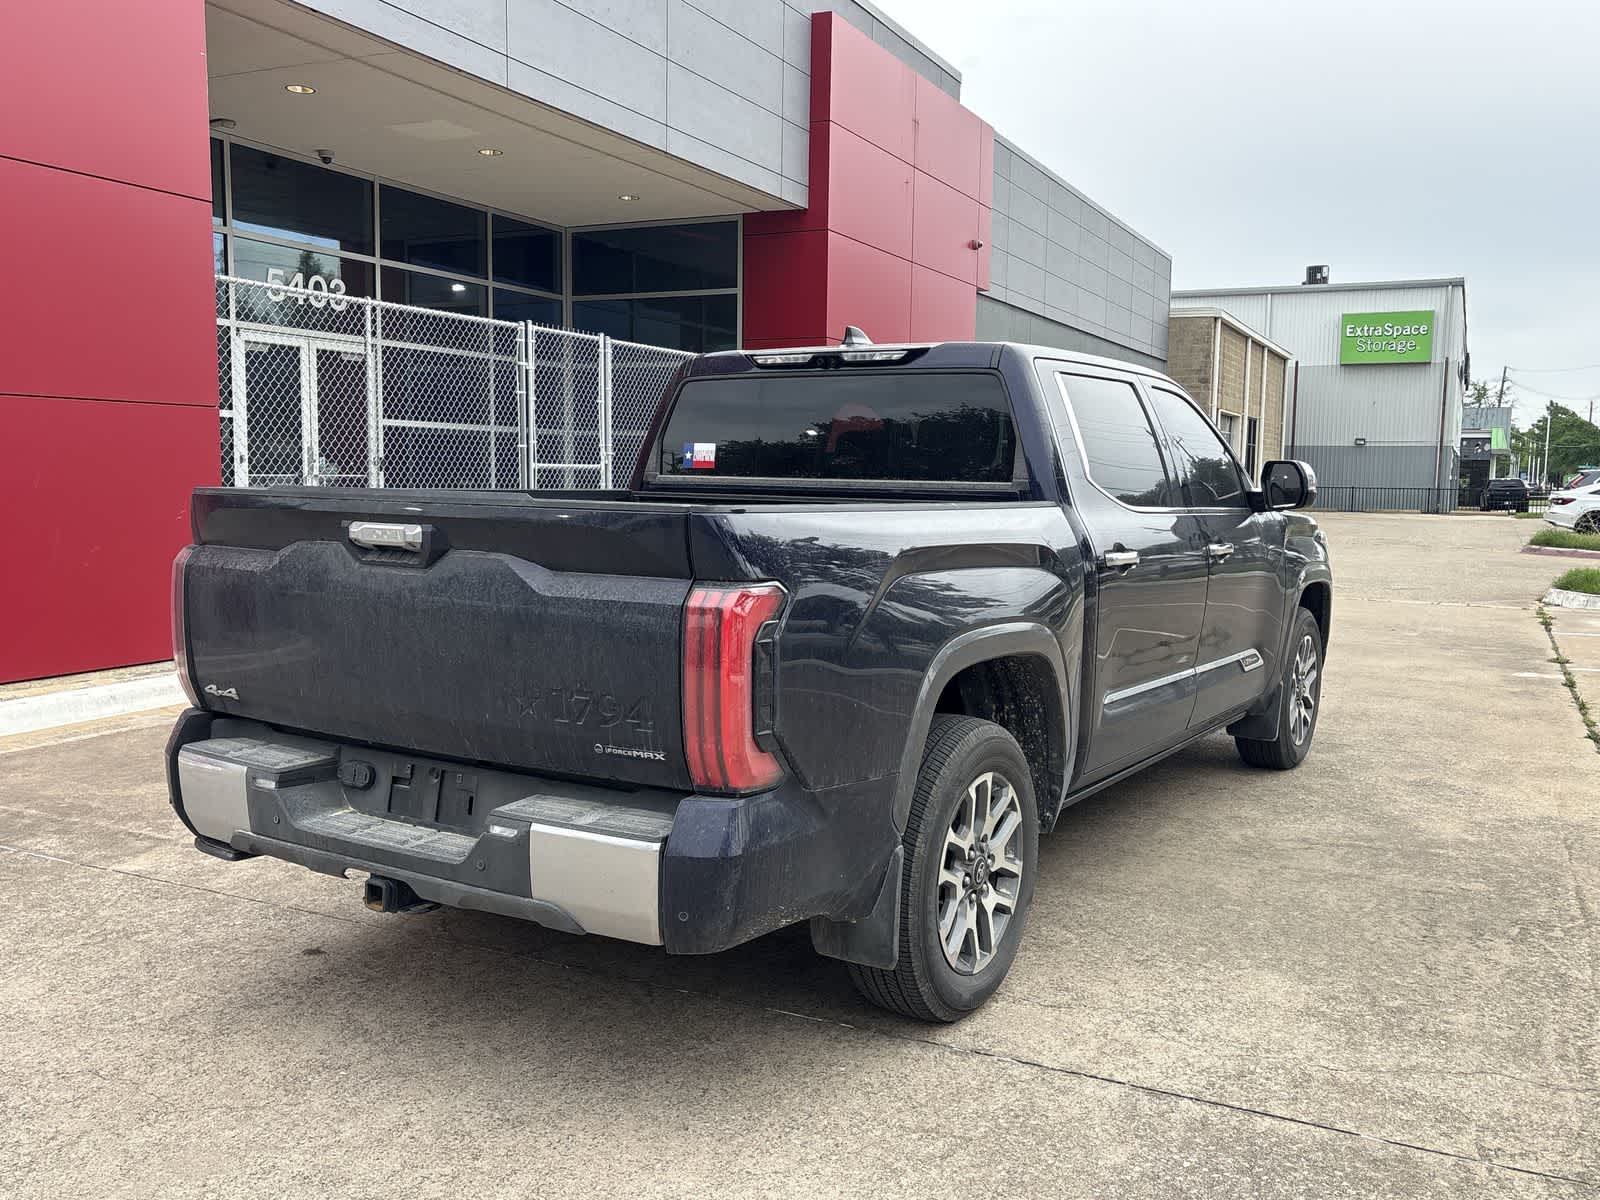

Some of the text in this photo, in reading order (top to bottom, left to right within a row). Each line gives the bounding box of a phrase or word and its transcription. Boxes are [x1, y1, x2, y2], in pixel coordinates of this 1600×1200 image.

[267, 268, 347, 311] 5403
[1356, 338, 1417, 354] Storage
[551, 687, 654, 733] 1794
